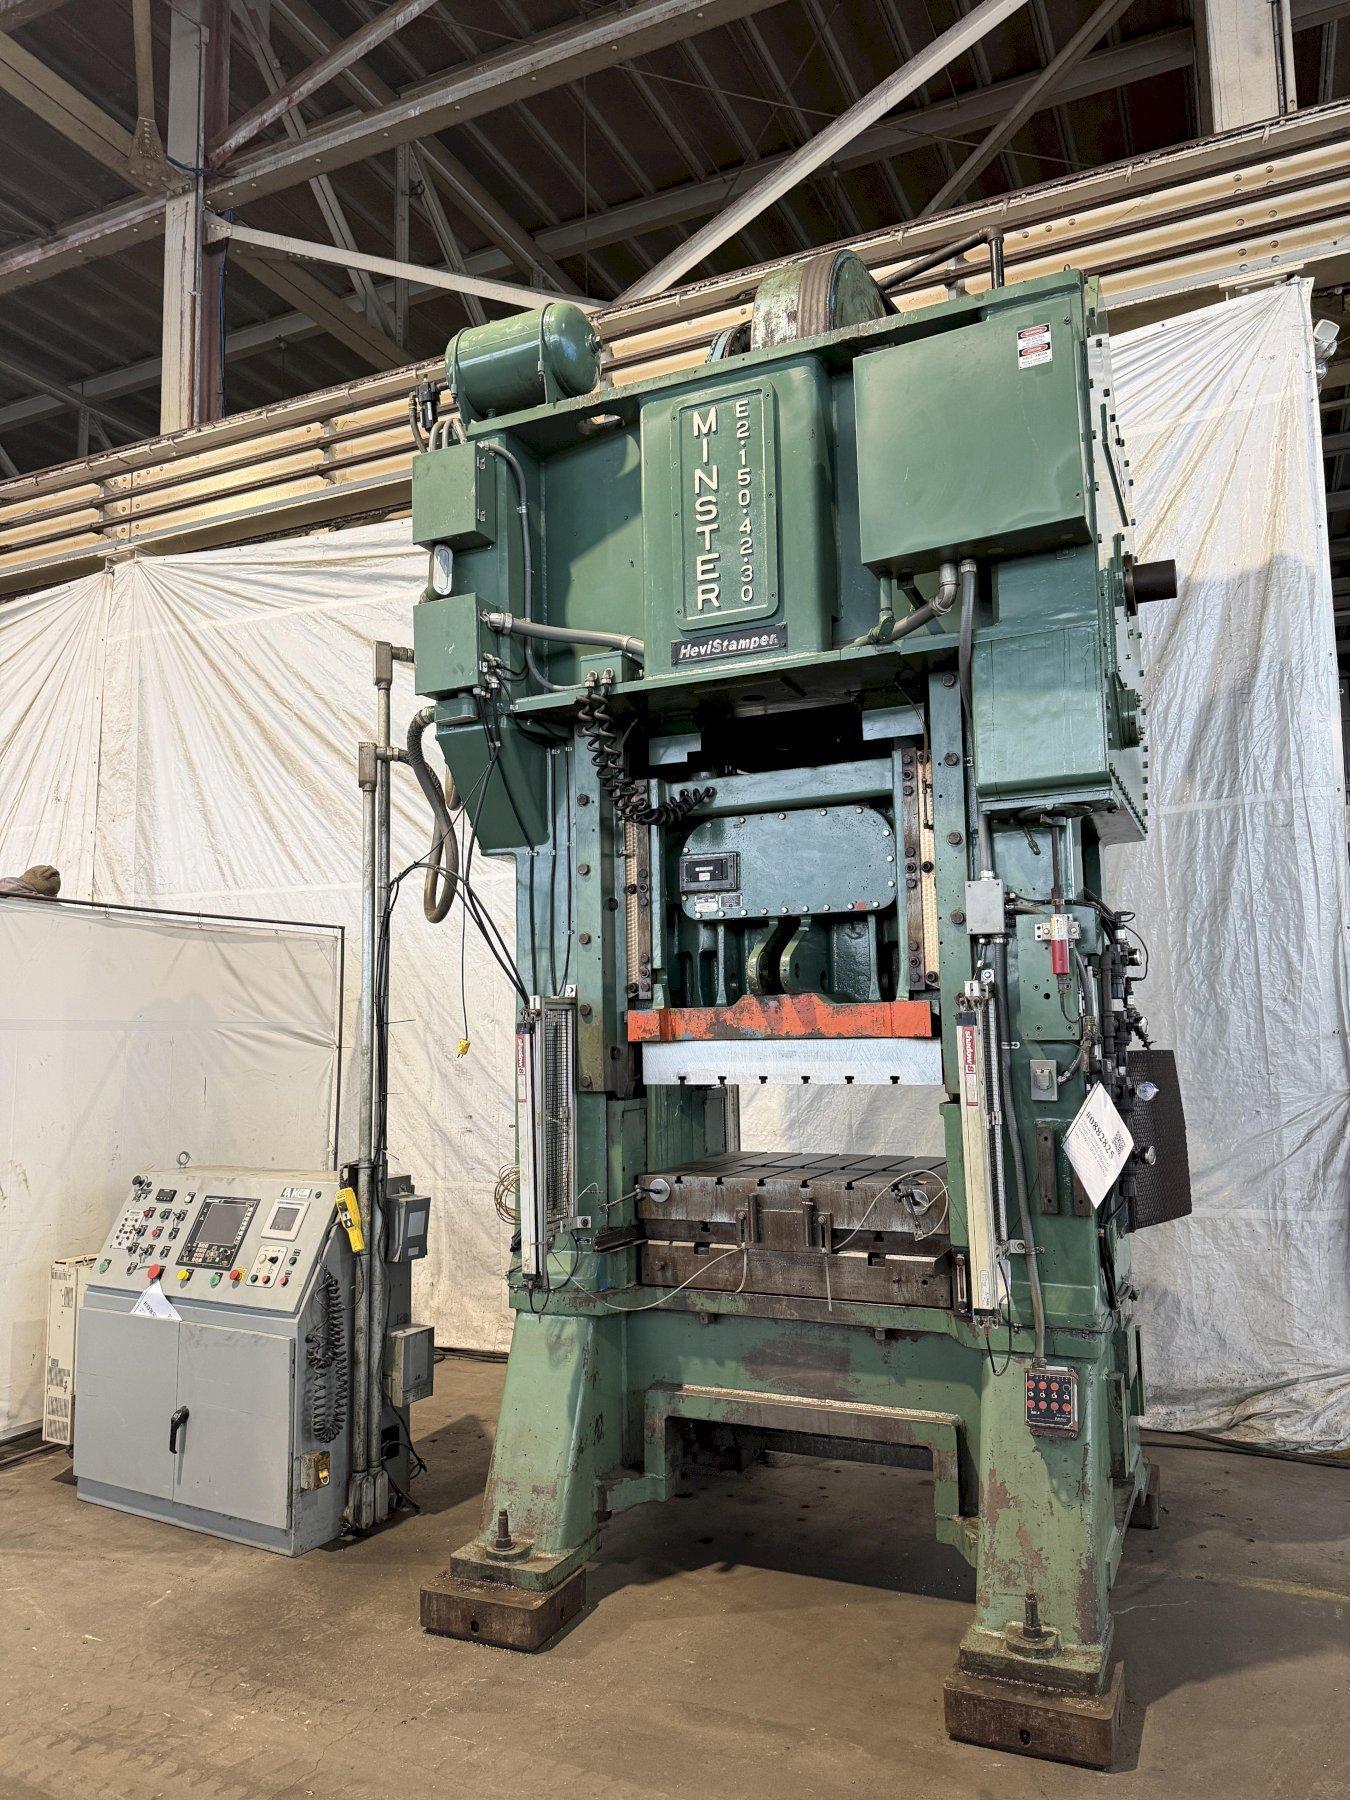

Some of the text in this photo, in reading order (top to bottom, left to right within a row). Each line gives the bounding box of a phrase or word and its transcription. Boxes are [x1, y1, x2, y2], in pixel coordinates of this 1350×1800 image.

[693, 406, 720, 610] MINSTER
[965, 1030, 974, 1065] shadow
[1085, 1111, 1115, 1159] #0882825
